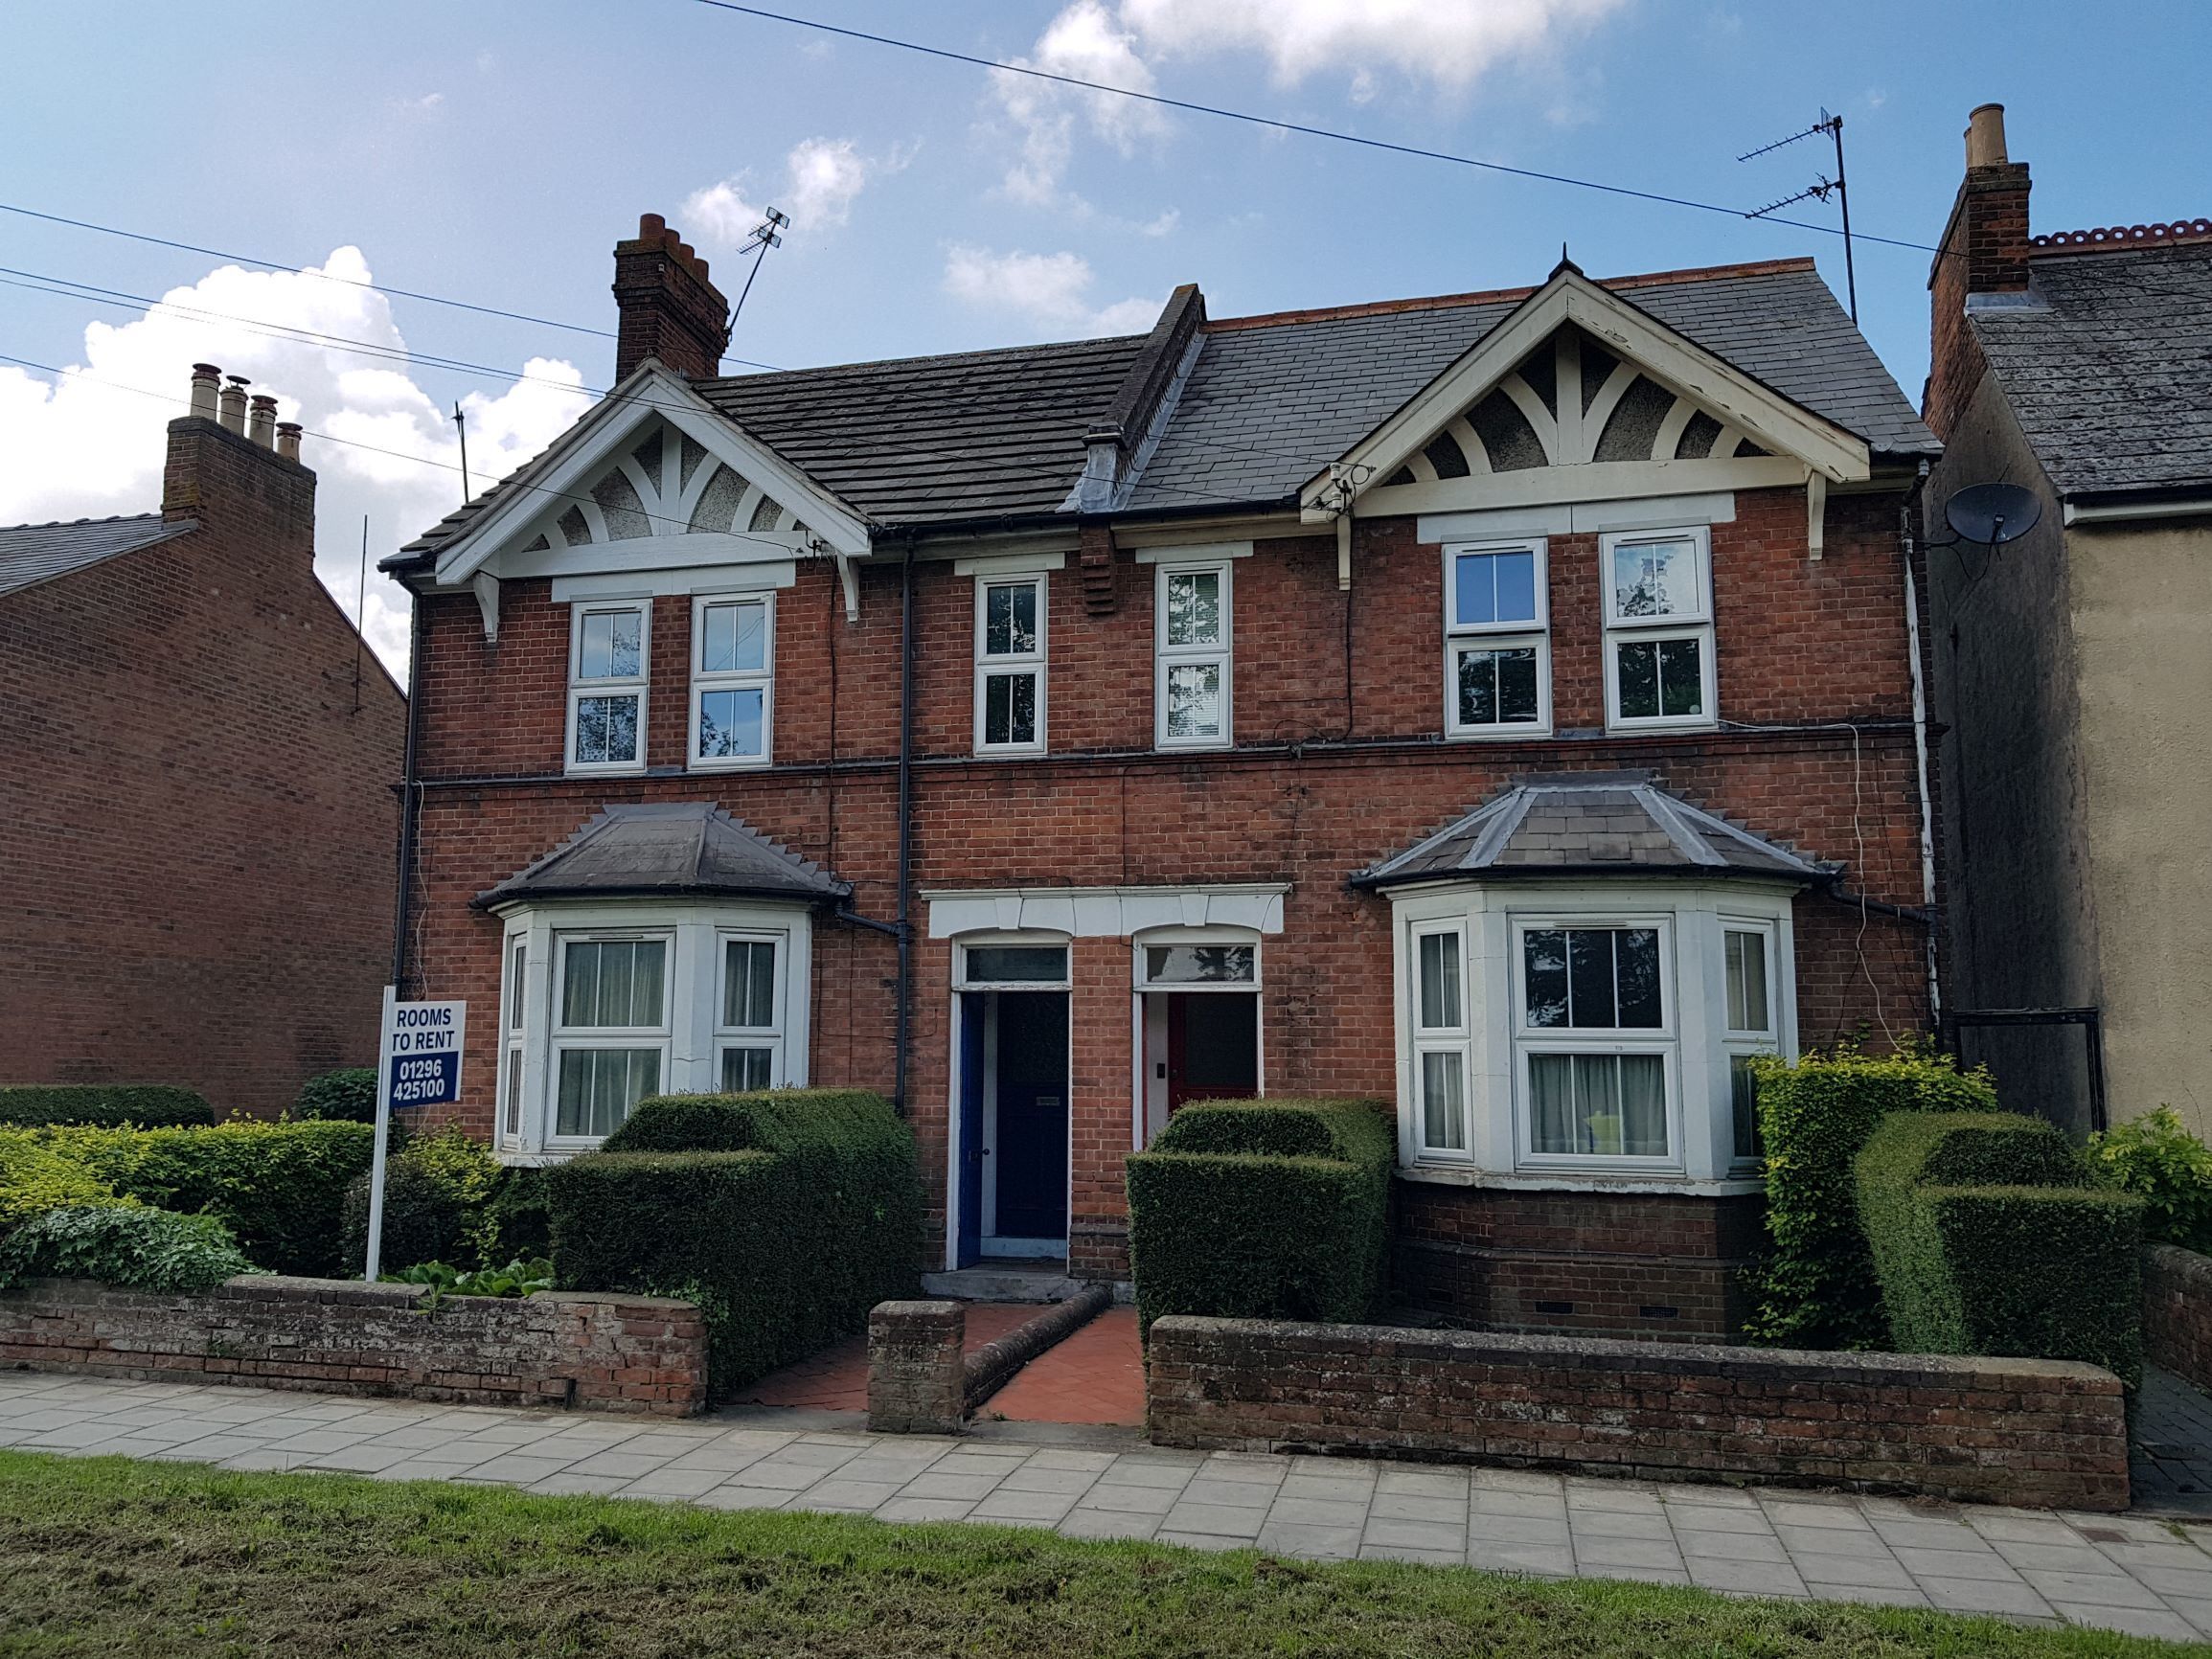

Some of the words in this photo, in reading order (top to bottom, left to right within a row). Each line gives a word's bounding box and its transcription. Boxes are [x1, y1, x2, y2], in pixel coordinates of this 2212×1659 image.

[397, 1008, 451, 1028] ROOMS
[392, 1033, 410, 1052] TO
[415, 1031, 455, 1050] RENT
[399, 1058, 443, 1079] 01296
[393, 1079, 445, 1101] 425100
